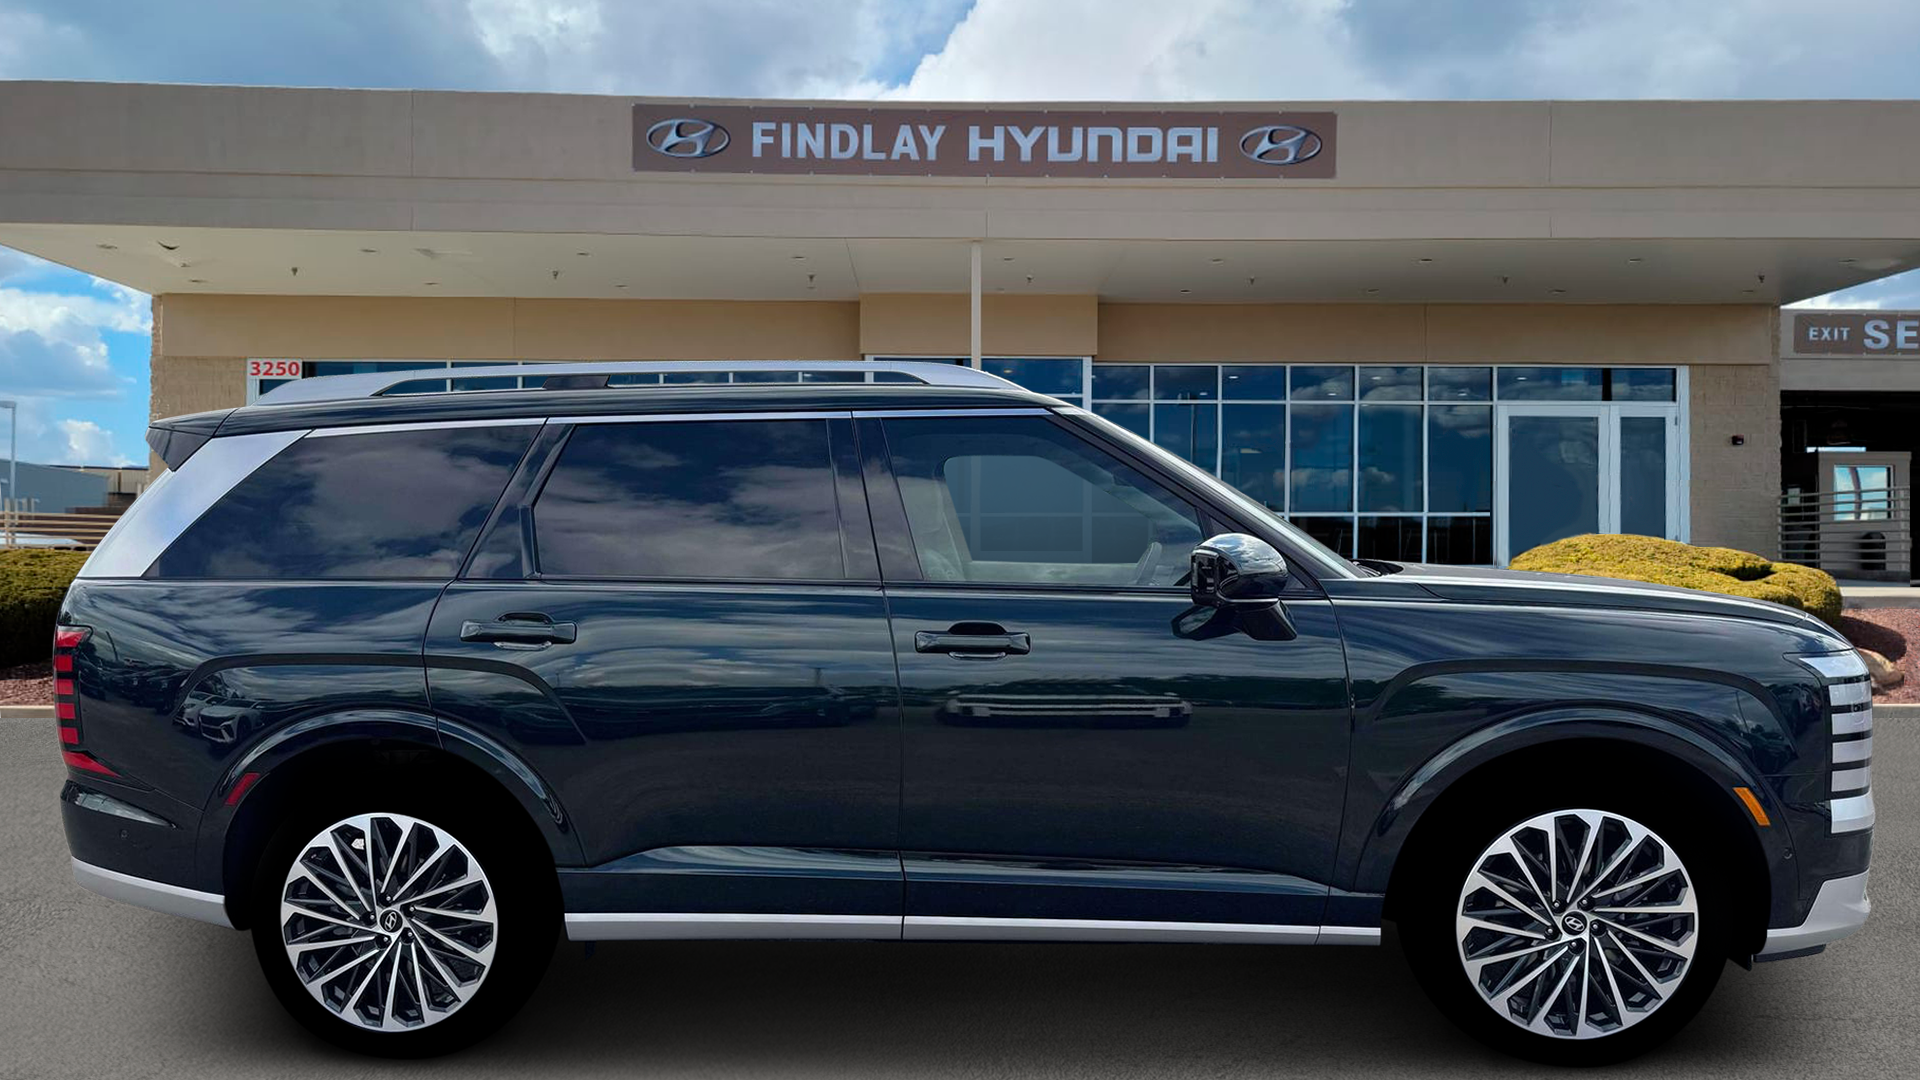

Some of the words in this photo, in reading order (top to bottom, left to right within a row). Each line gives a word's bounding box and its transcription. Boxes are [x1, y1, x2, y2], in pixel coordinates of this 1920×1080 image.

[752, 121, 947, 162] FINDLAY
[968, 125, 1219, 163] HYUNDAI
[1808, 326, 1850, 341] EXIT
[1863, 319, 1920, 349] SE
[249, 361, 300, 376] 3250
